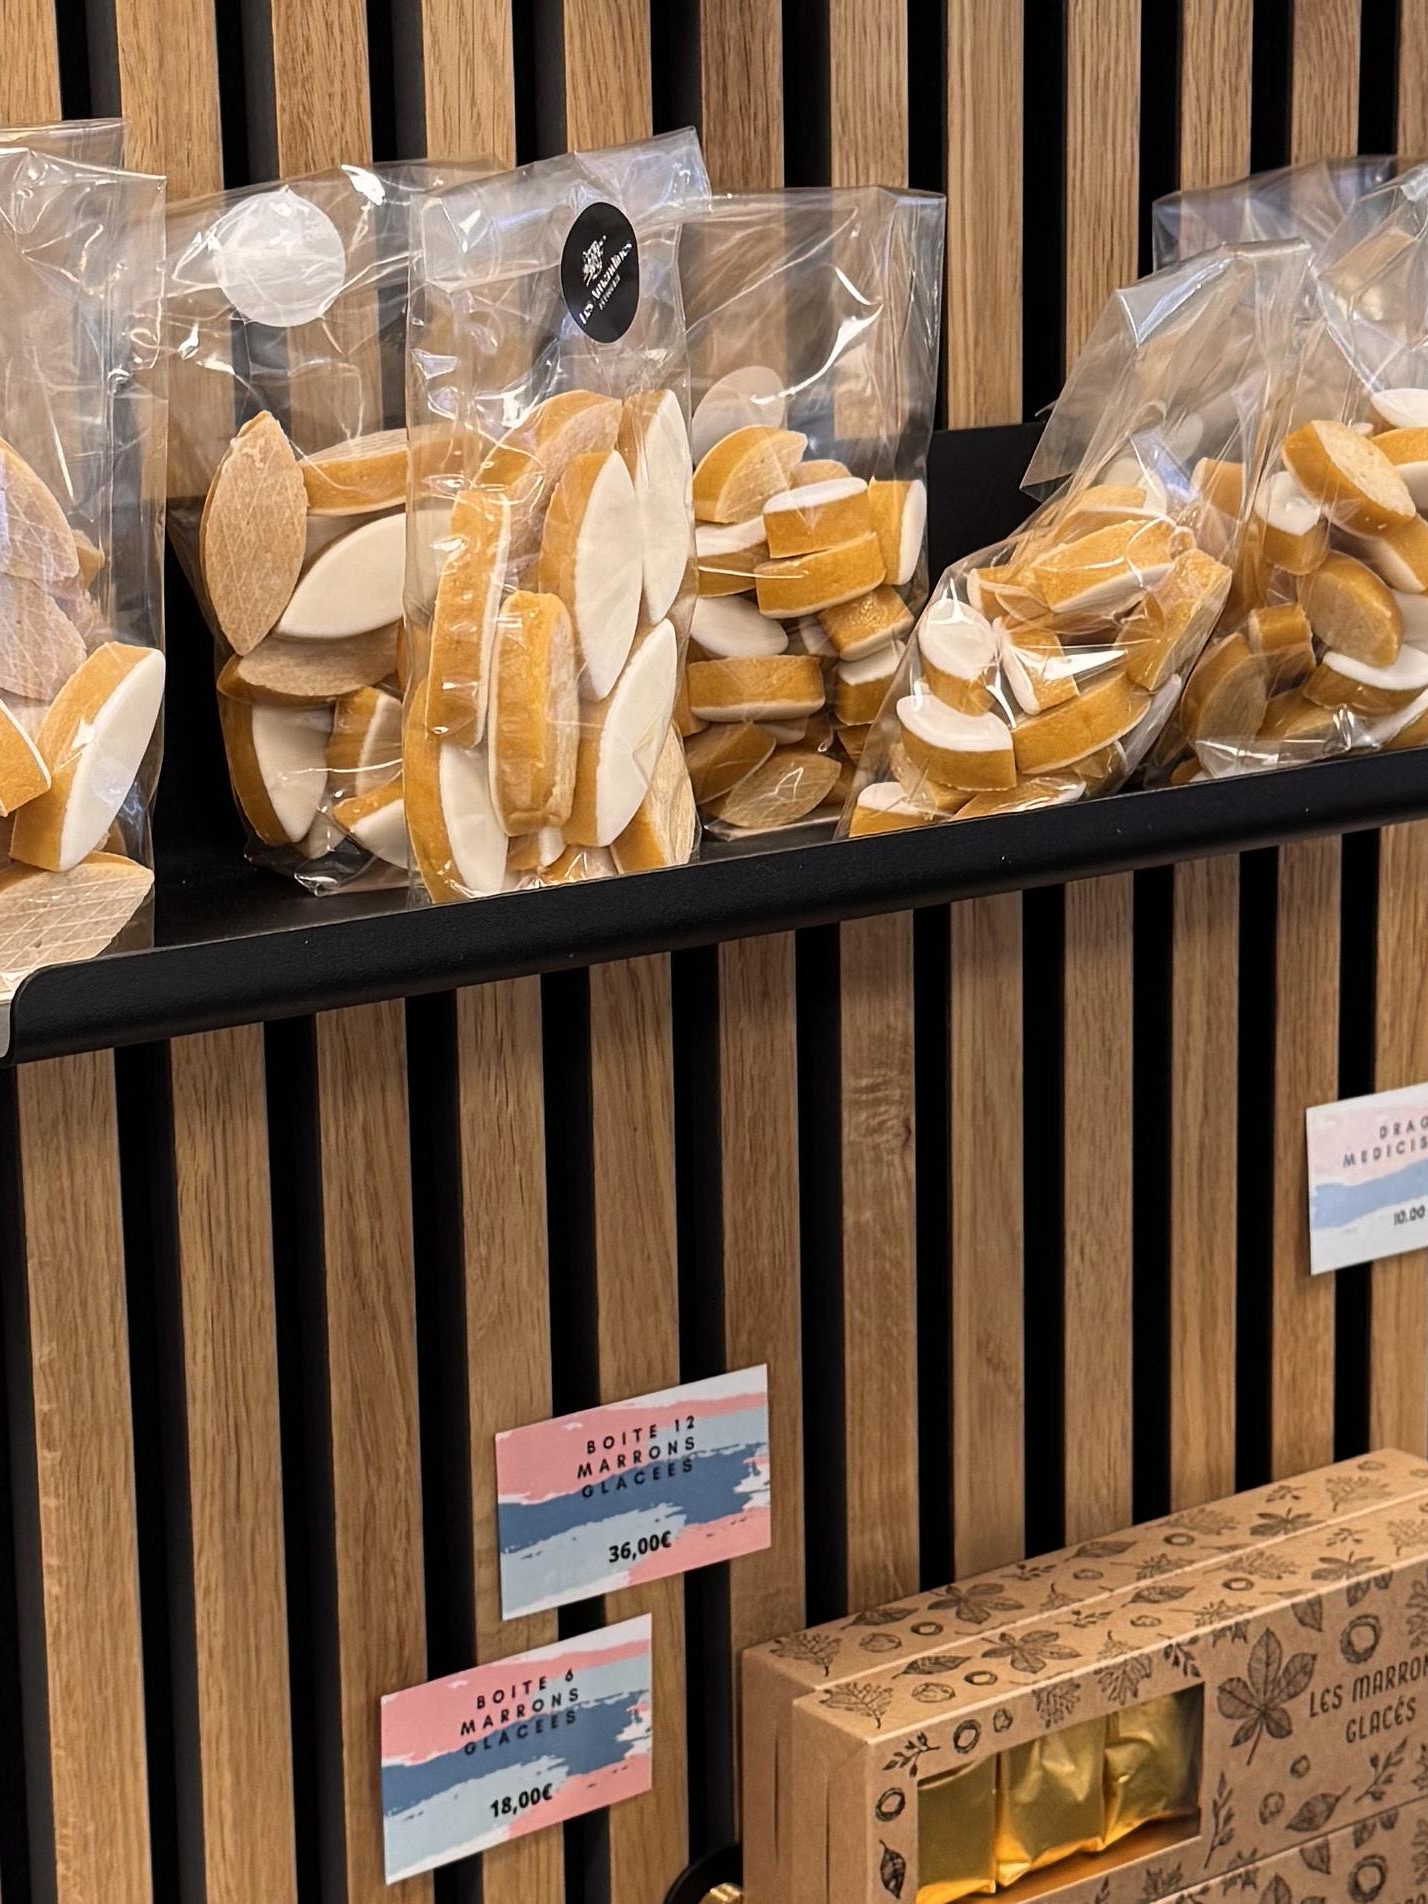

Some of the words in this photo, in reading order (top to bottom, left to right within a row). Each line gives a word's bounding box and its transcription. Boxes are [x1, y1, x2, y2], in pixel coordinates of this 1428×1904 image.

[1343, 1136, 1428, 1169] MEDICIS
[586, 1423, 659, 1455] BOITE
[674, 1415, 696, 1433] 12
[577, 1436, 696, 1480] MARRONS
[582, 1458, 694, 1499] GLACEES
[608, 1530, 673, 1564] 36,00€
[477, 1674, 548, 1711] BOITE
[564, 1668, 575, 1683] 6
[1309, 1684, 1343, 1718] LES
[460, 1688, 580, 1737] MARRONS
[464, 1709, 578, 1756] GLACEES
[1345, 1695, 1417, 1744] GLACÉS
[490, 1783, 554, 1818] 18,00€
